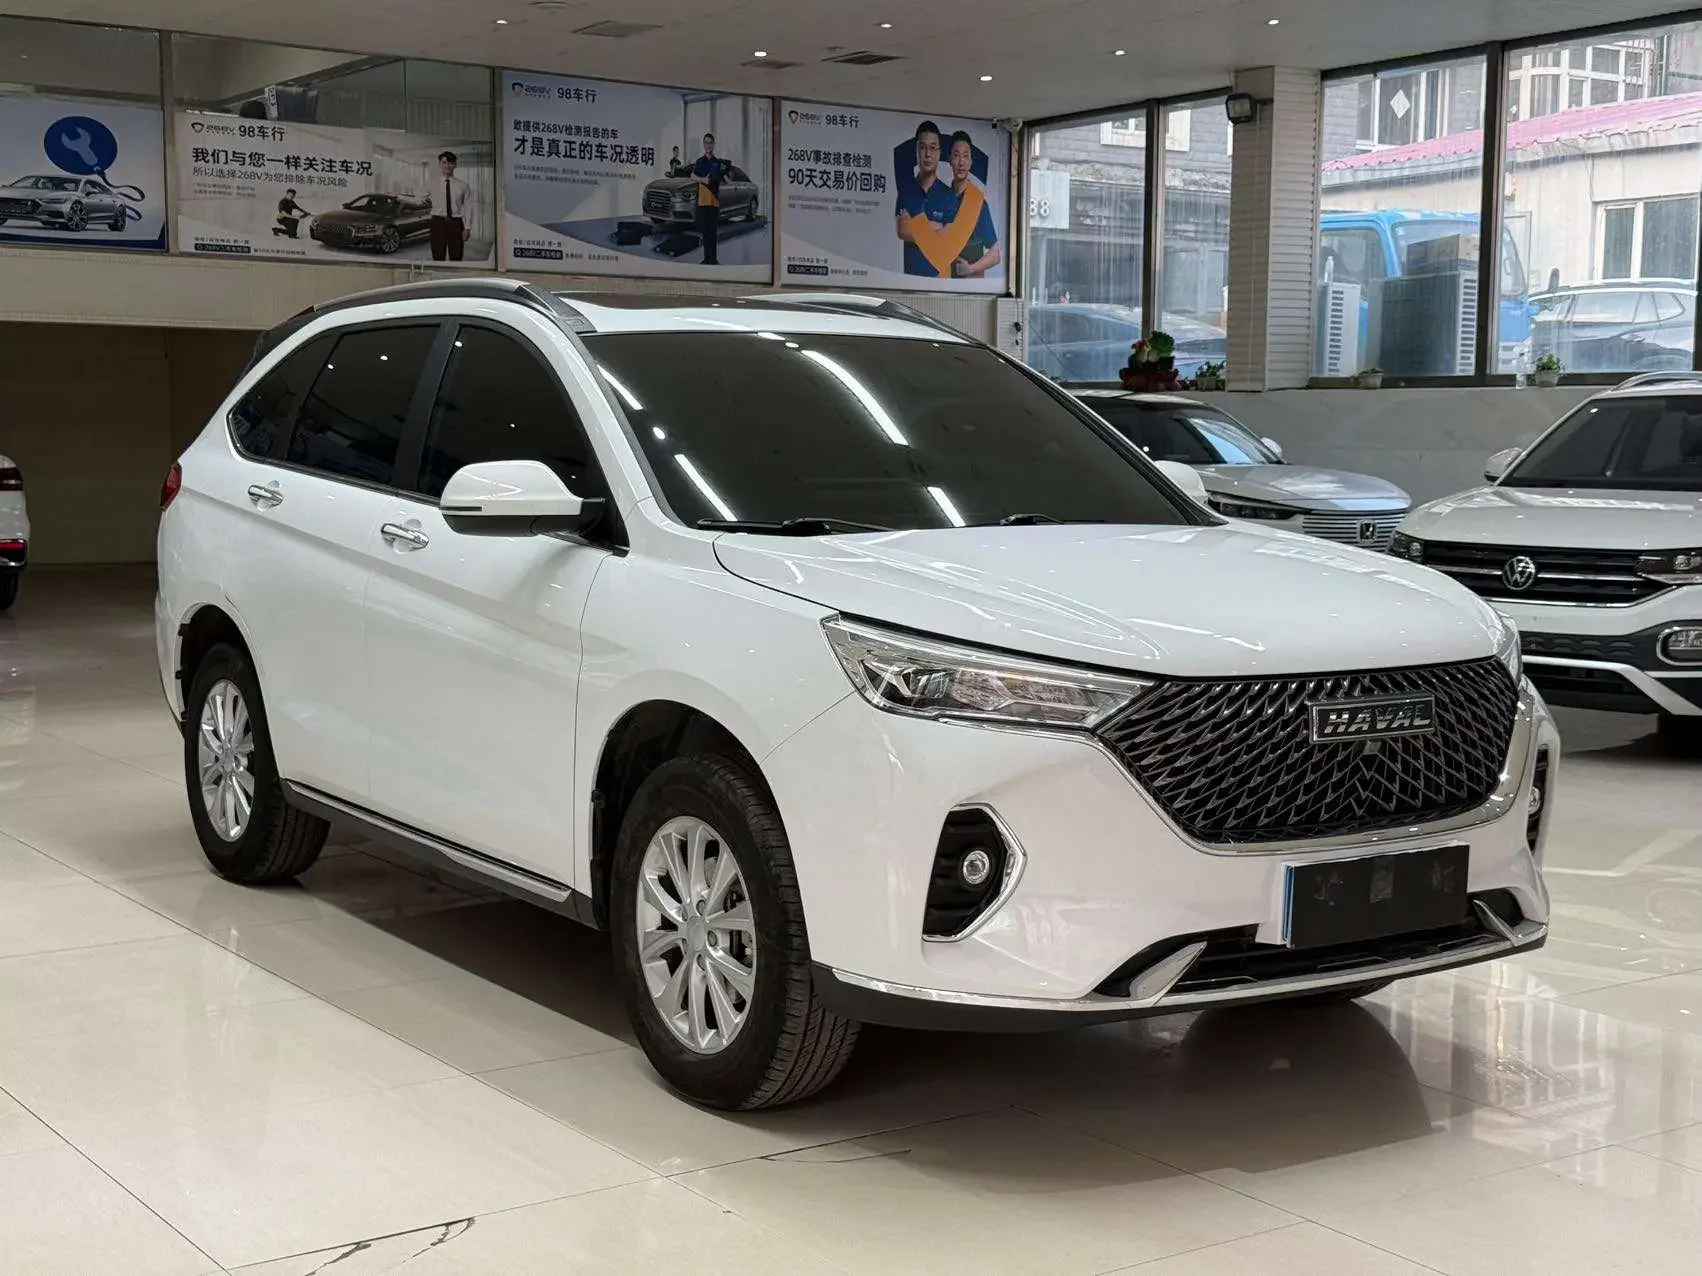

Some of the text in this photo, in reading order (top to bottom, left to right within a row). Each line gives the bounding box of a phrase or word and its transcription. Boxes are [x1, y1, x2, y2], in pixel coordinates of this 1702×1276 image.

[557, 87, 597, 103] 98车行
[825, 114, 859, 128] 98车行
[238, 125, 285, 142] 98车行
[513, 135, 655, 166] 才是真正的车况透明
[787, 148, 873, 168] 268V事故排查检测
[191, 147, 373, 177] 我们与您一样关注车况
[192, 166, 349, 188] 所以选择268V为您排除车况风险
[788, 167, 887, 193] 90天交易价回购
[1324, 704, 1431, 734] HAVAL
